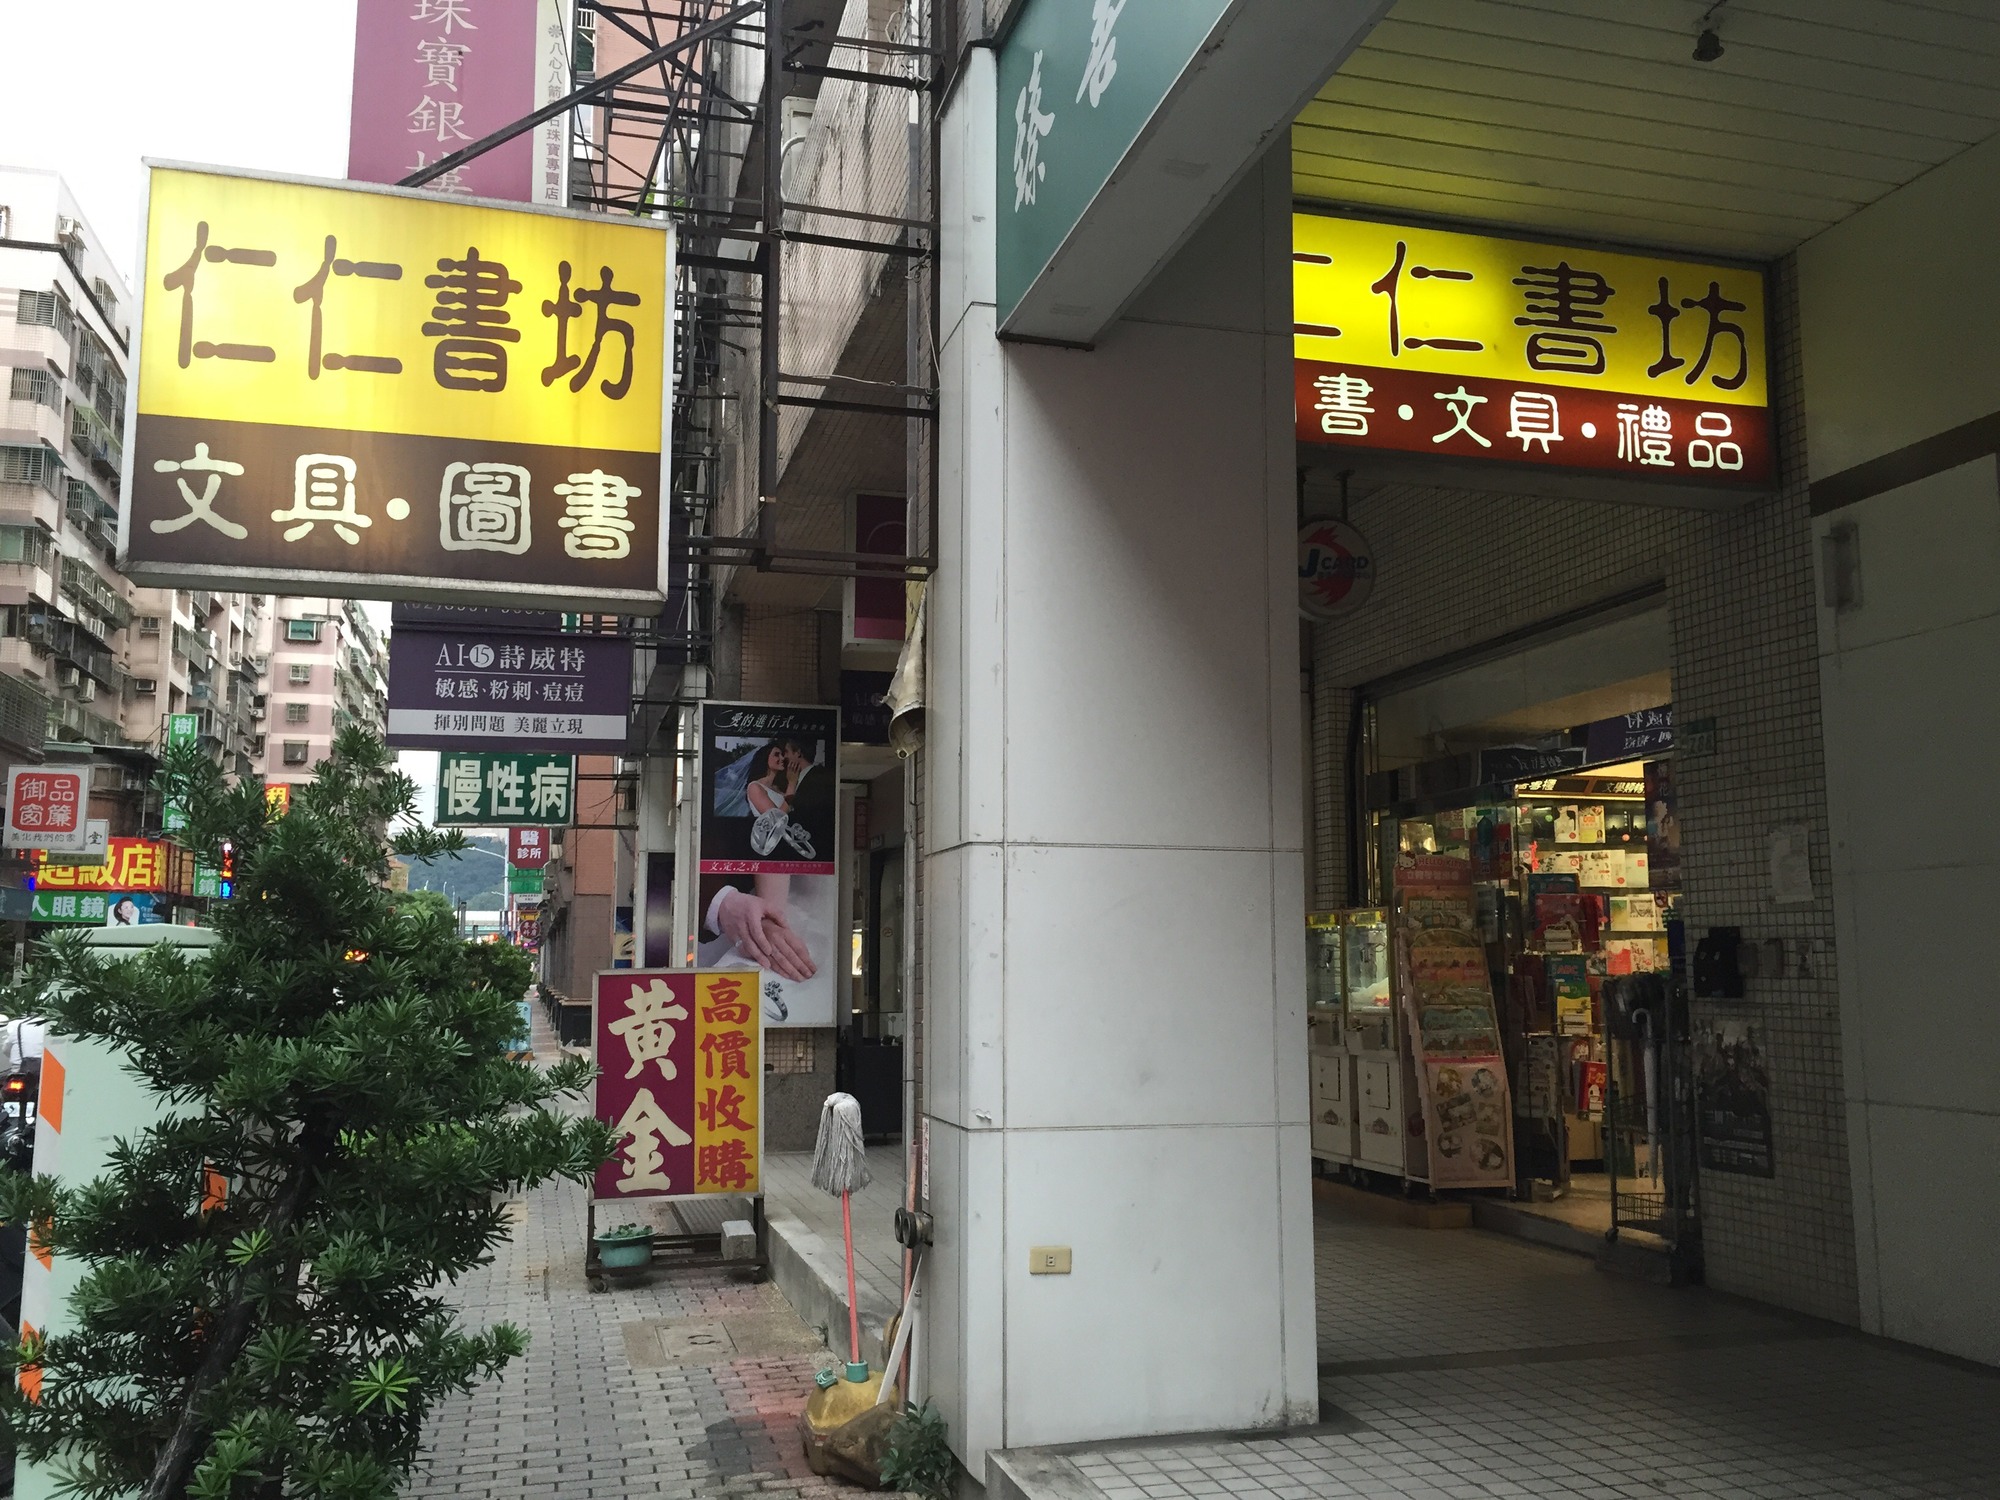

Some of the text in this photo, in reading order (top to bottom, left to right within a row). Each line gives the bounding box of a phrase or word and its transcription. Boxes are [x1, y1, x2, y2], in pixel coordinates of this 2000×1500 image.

[163, 220, 641, 400] 仁仁書坊
[500, 645, 586, 673] 詩威特
[434, 713, 584, 735] 揮別問題 美麗立現
[442, 758, 570, 819] 慢性病
[517, 847, 542, 860] 診所
[607, 978, 693, 1193] 黃金
[697, 977, 756, 1190] 高價收購
